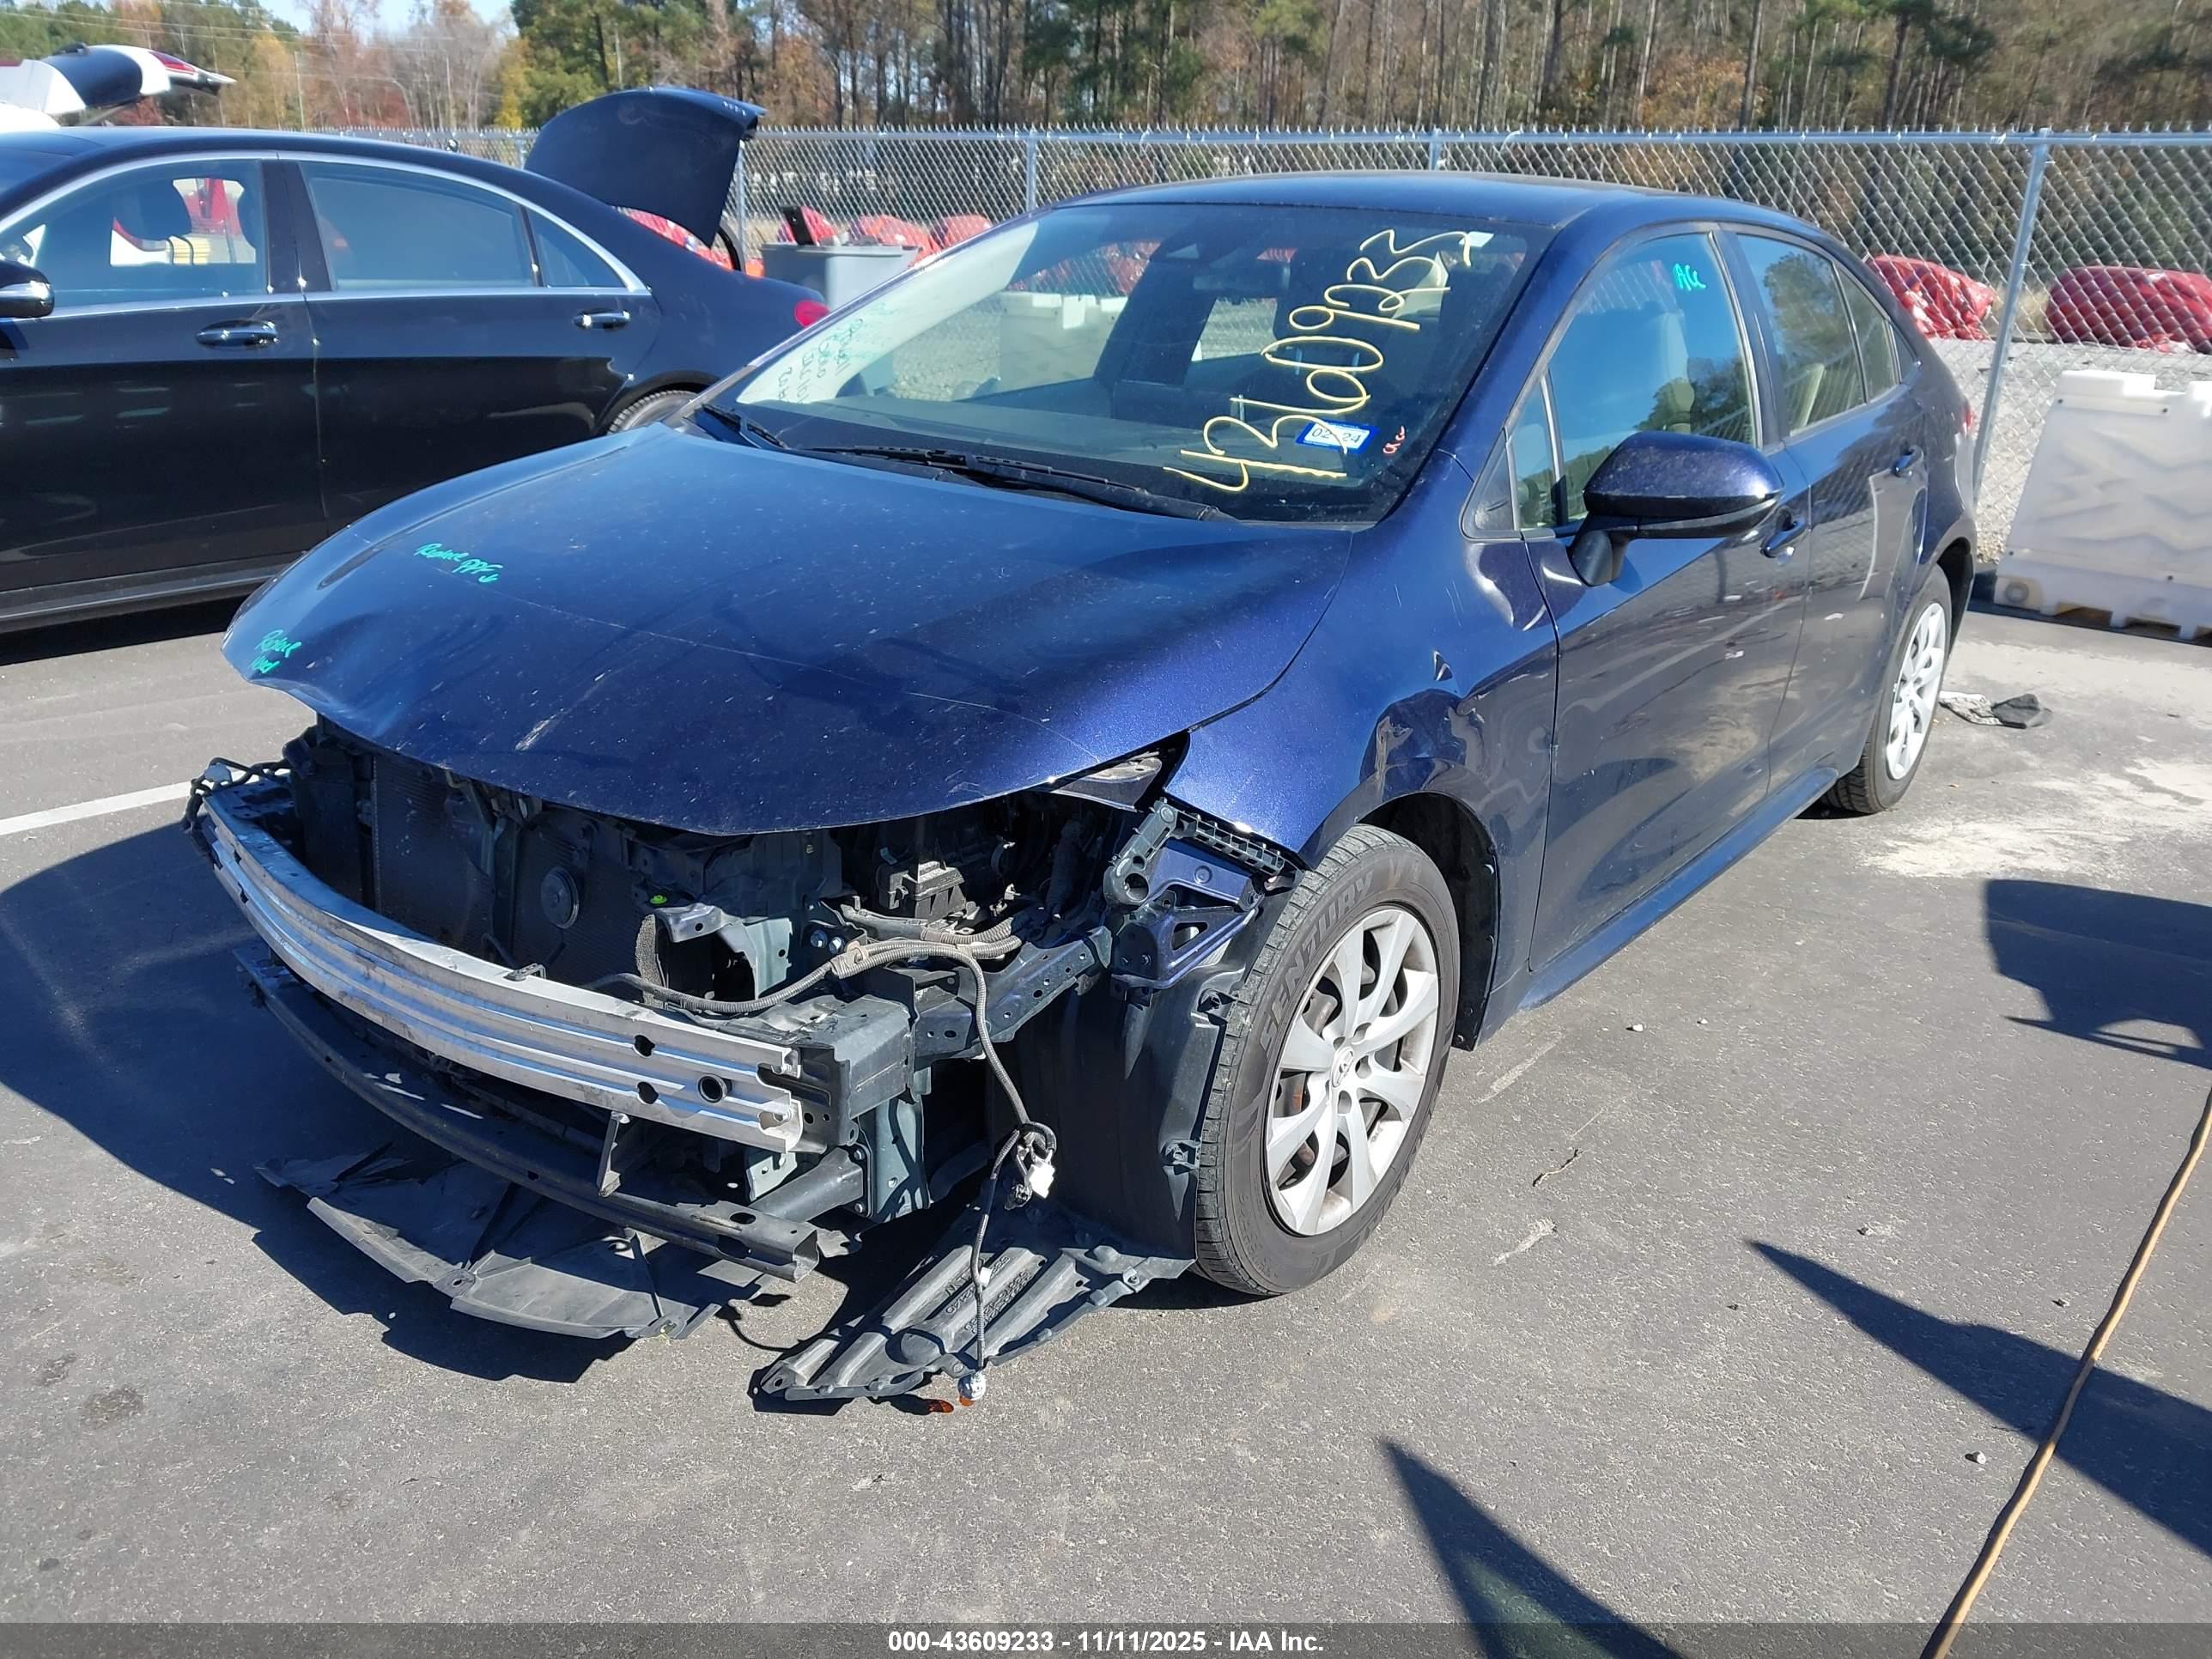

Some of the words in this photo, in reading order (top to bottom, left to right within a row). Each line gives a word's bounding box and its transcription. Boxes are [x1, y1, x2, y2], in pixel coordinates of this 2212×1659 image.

[1162, 228, 1472, 492] 43609233
[1342, 432, 1363, 444] 24
[1259, 870, 1375, 1059] SENTURY
